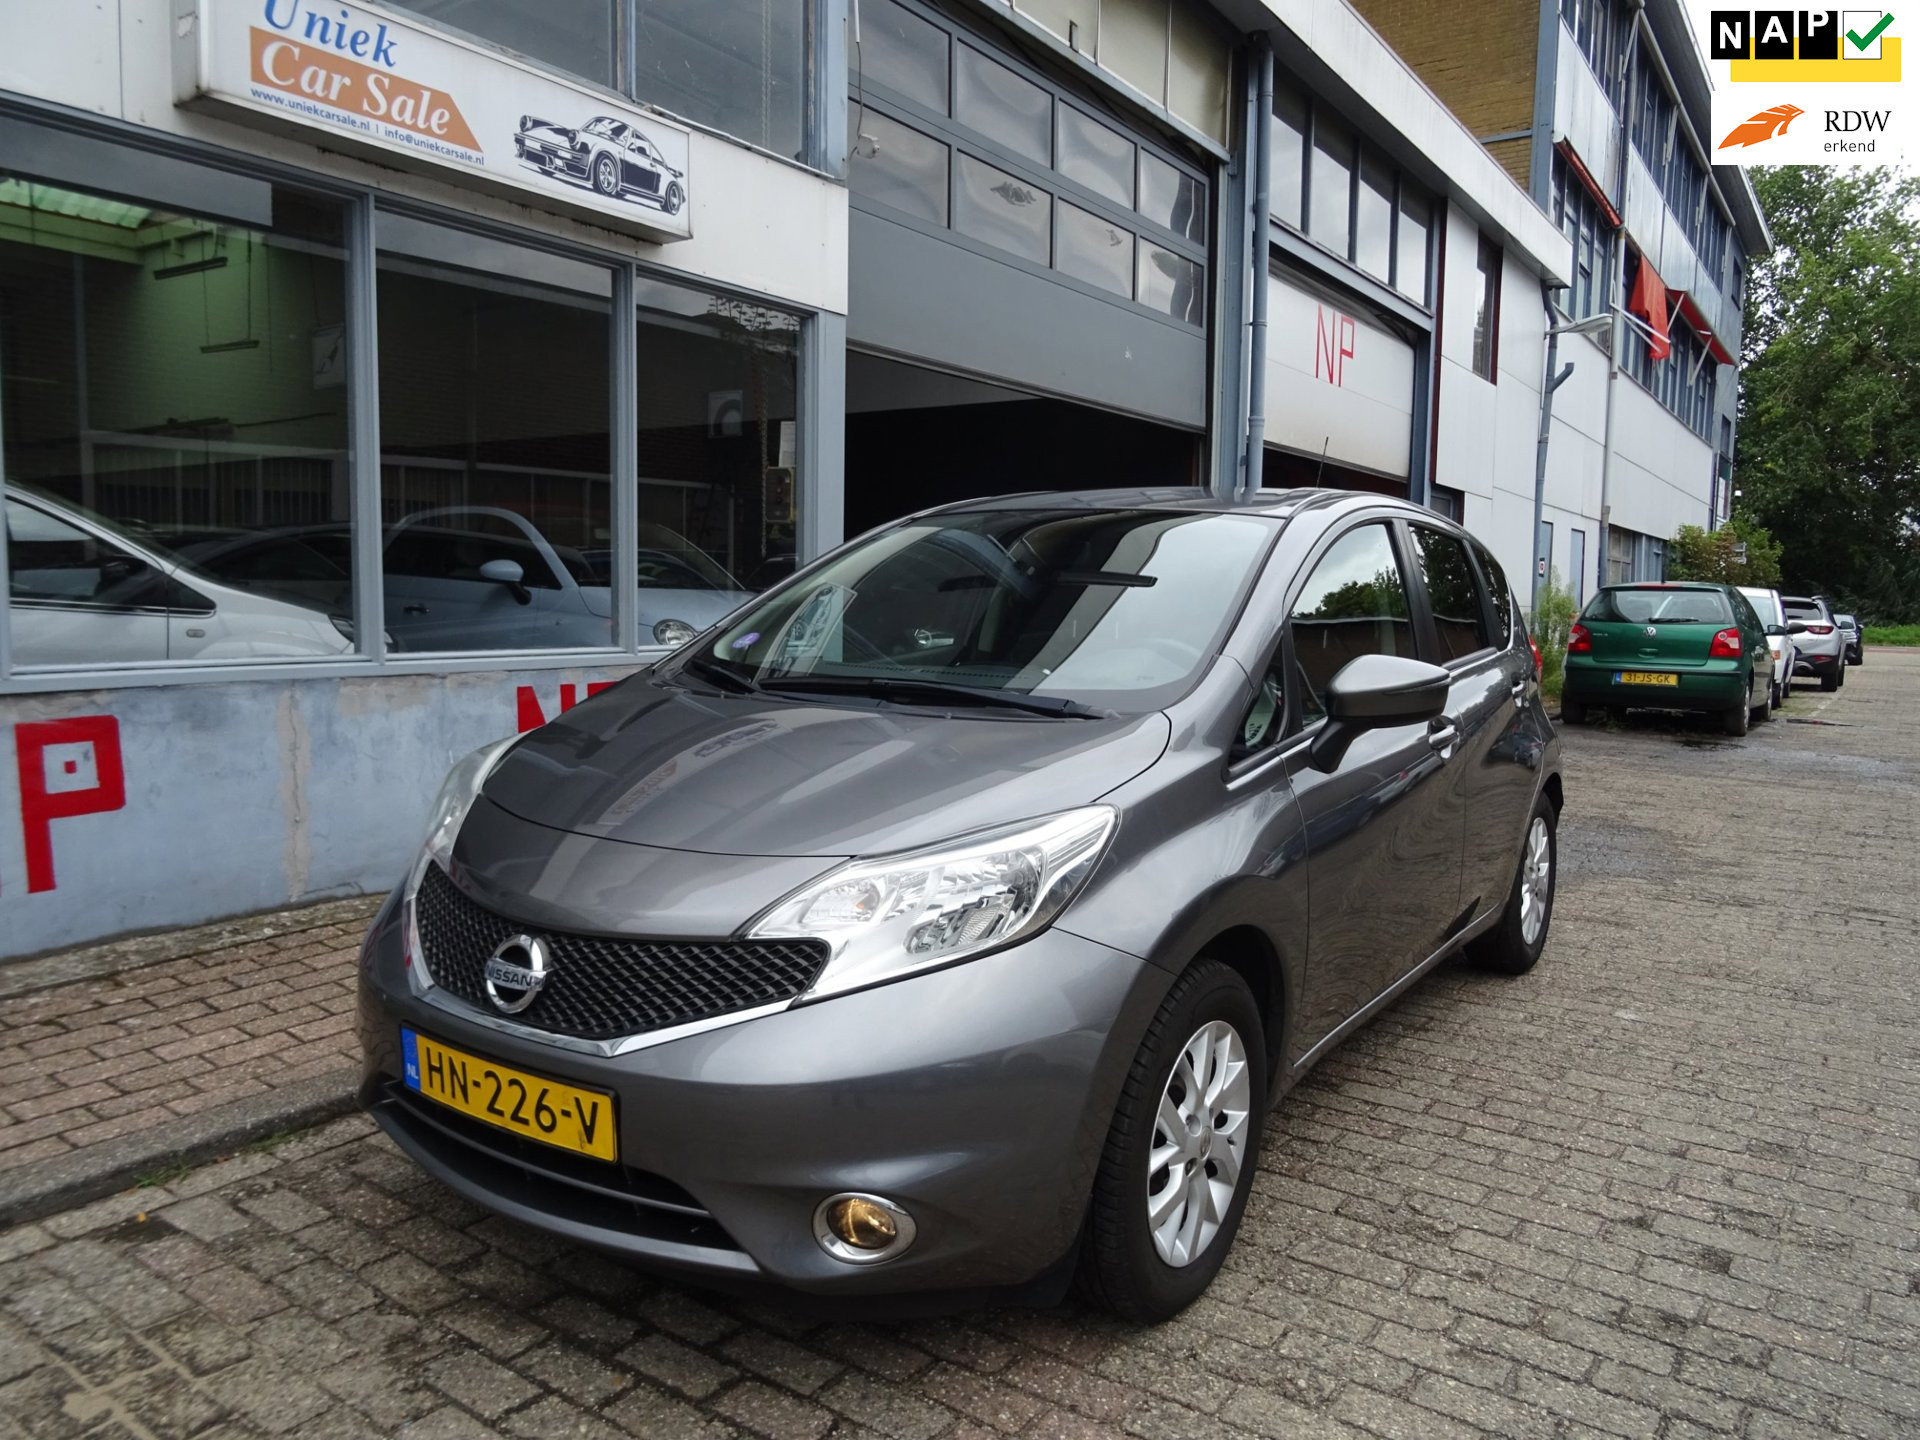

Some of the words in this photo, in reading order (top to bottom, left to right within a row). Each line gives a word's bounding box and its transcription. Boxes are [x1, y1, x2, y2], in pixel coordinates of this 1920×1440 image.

[264, 0, 398, 67] Uniek
[250, 87, 370, 131] www.uniekcarsale.nl
[384, 126, 485, 166] info@uniekcarsale.nl
[262, 40, 352, 101] Car
[362, 73, 450, 136] Sale
[1315, 303, 1355, 388] NP
[1625, 673, 1671, 684] 31-JS-GK
[486, 963, 533, 987] NISSAN
[426, 1046, 599, 1145] HN-226-V
